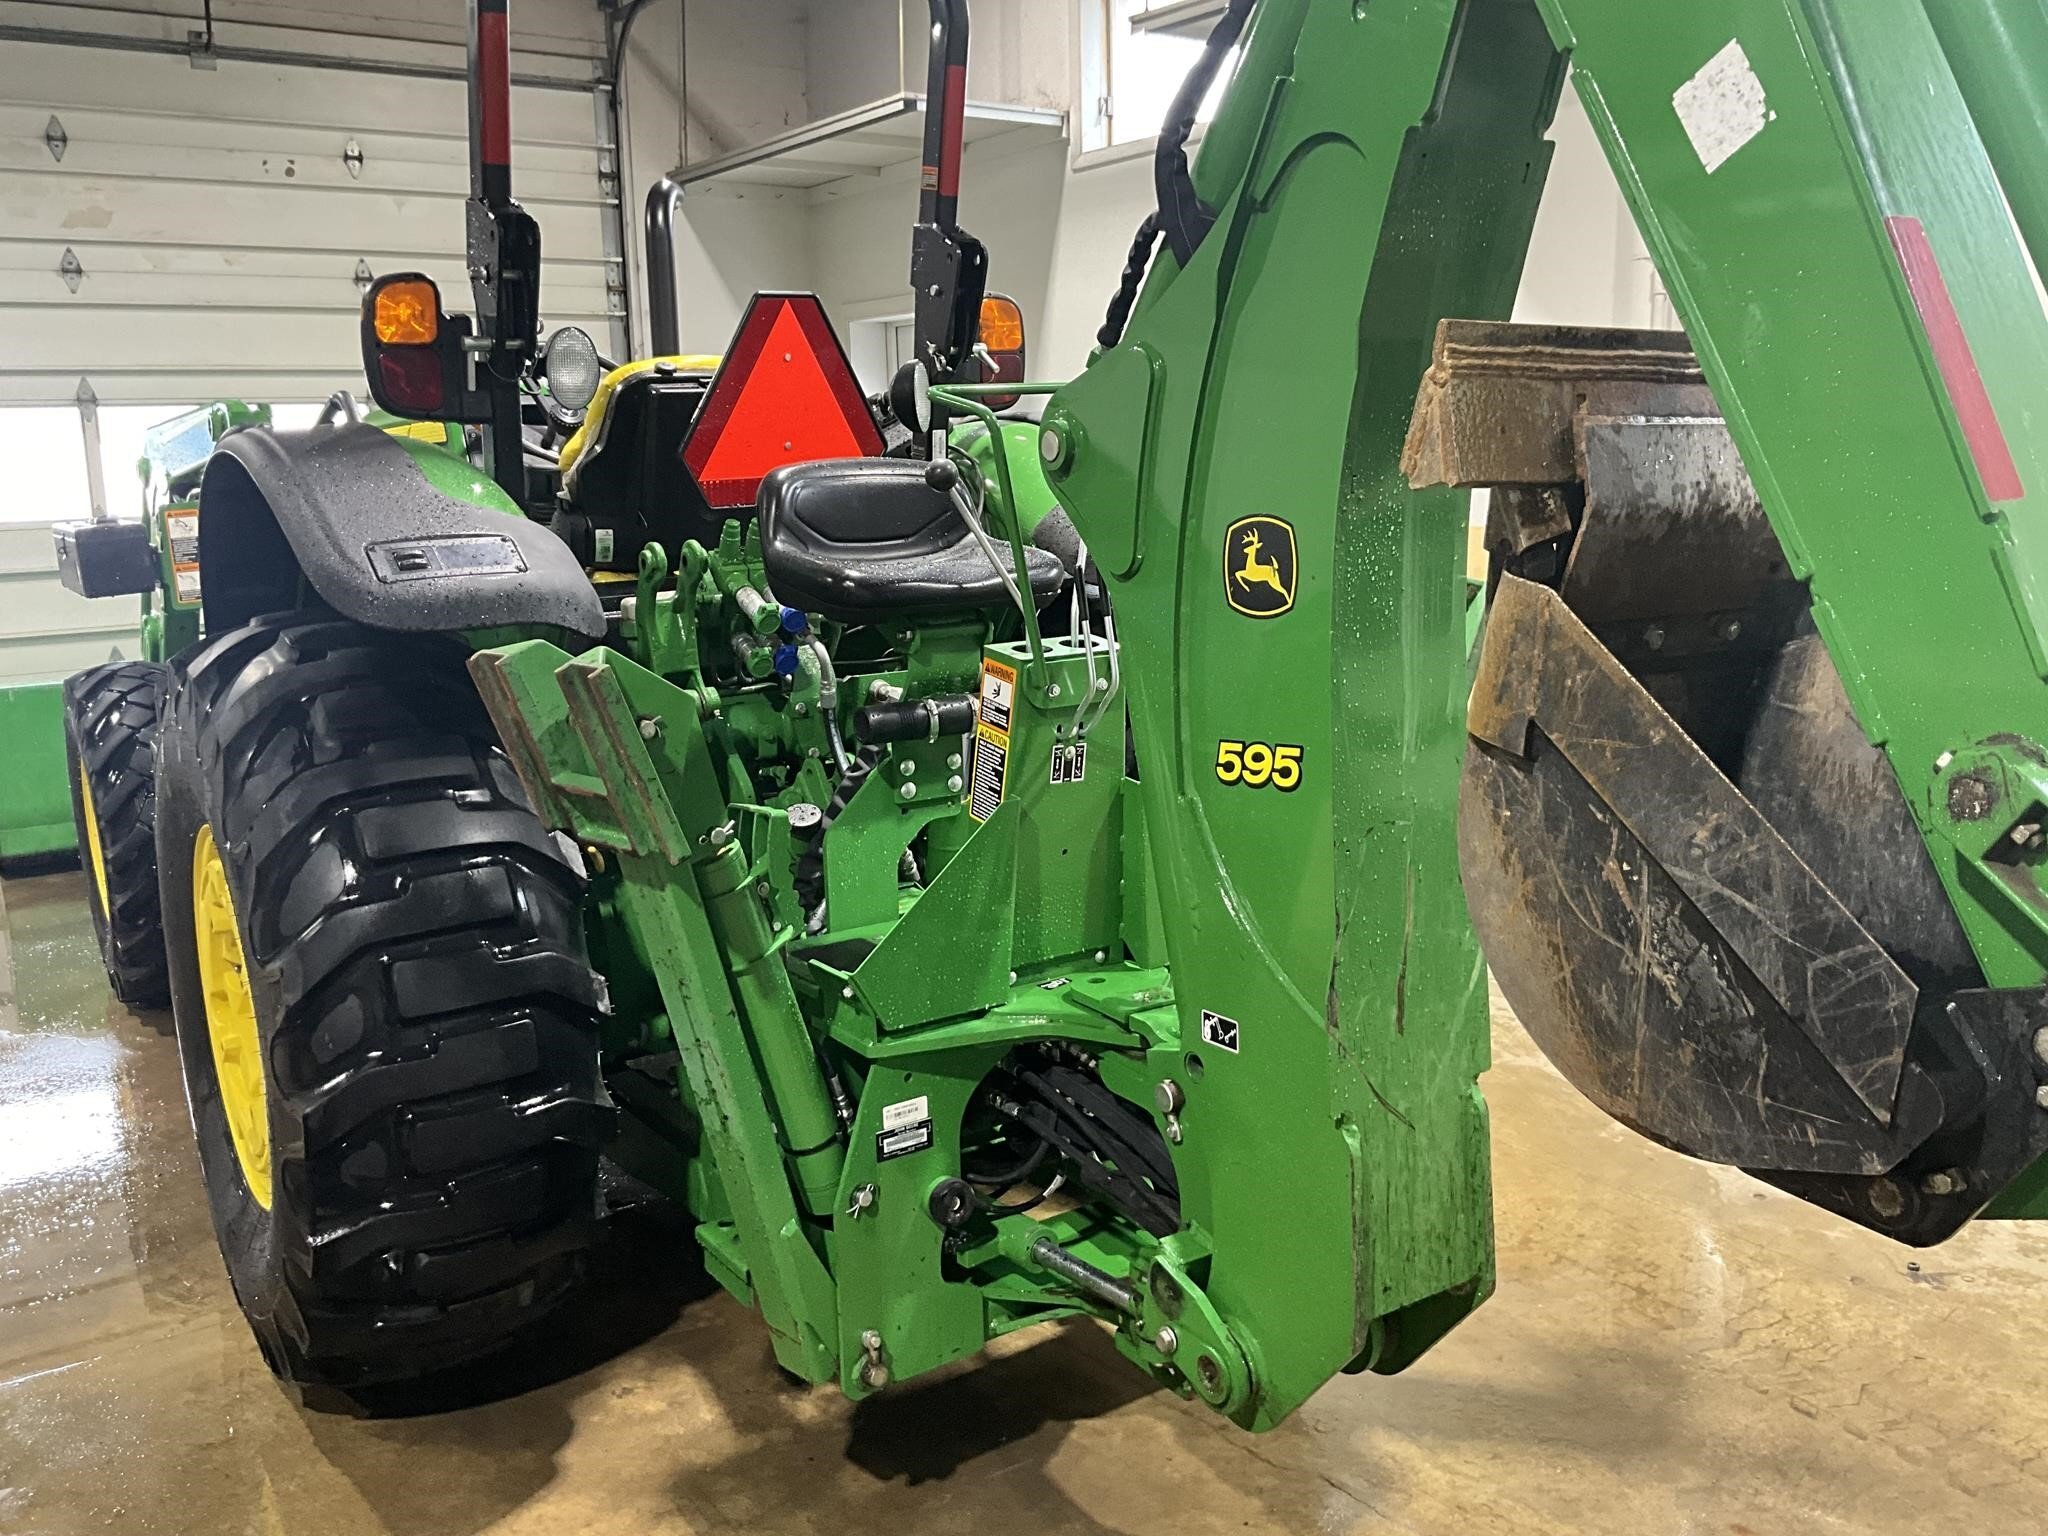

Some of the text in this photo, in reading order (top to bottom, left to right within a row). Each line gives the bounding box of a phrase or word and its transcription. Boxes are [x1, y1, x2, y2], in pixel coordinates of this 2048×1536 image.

[991, 667, 1014, 682] WARNING
[985, 732, 1007, 748] CAUTION
[1215, 740, 1304, 792] 595
